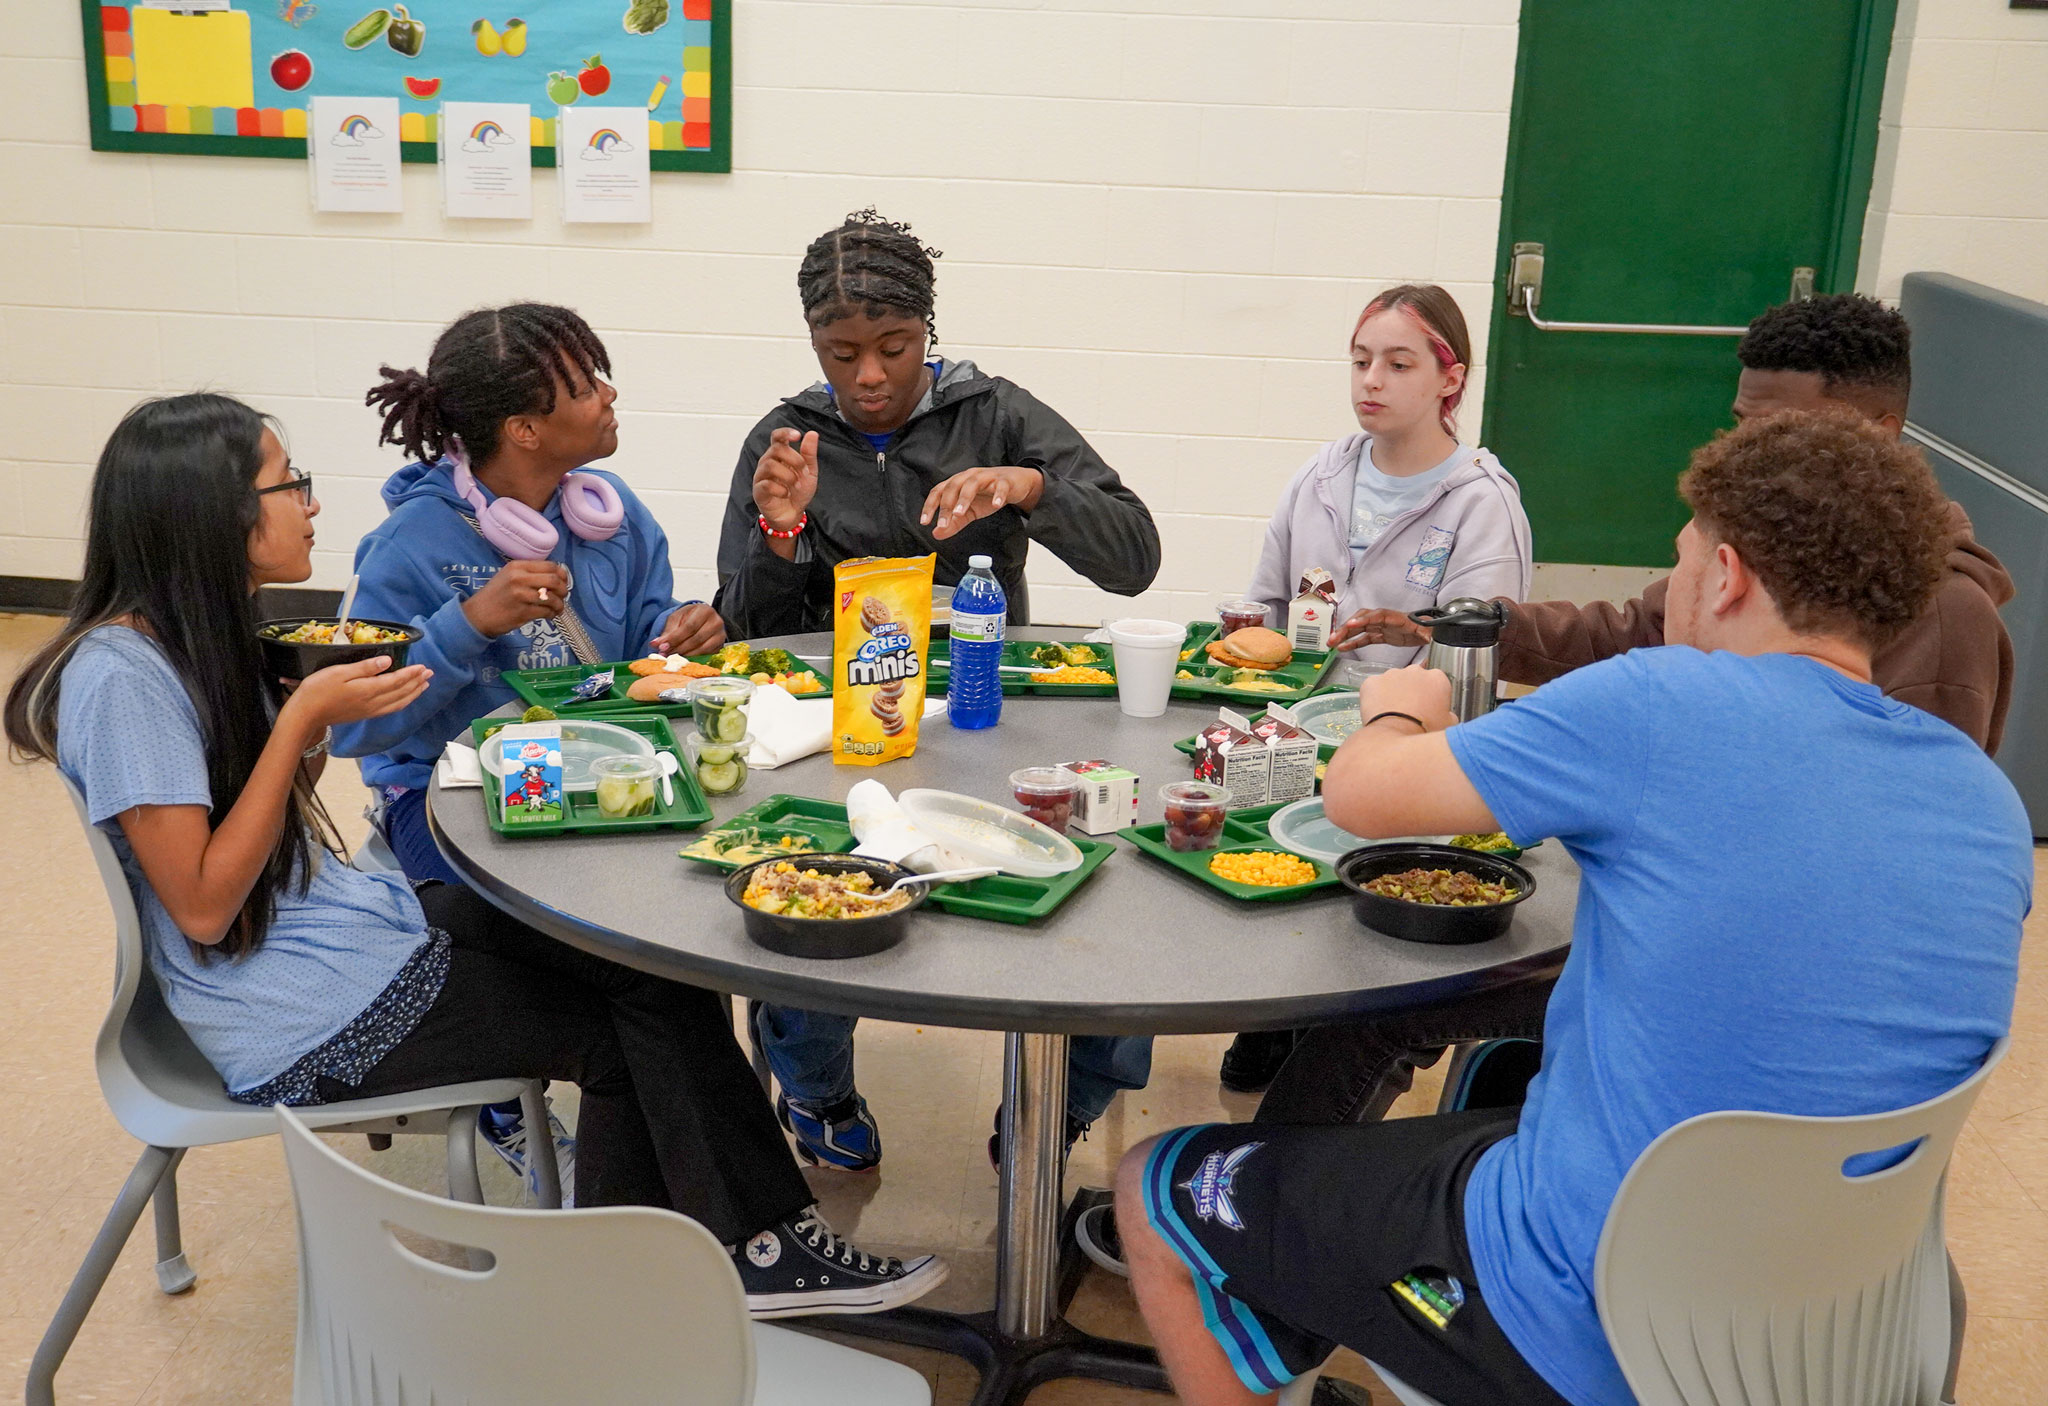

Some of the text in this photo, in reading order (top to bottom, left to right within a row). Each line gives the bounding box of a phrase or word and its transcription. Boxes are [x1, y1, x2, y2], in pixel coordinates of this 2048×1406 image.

[859, 635, 911, 661] OREO
[848, 650, 920, 685] minis
[1200, 1154, 1220, 1214] HORNETS
